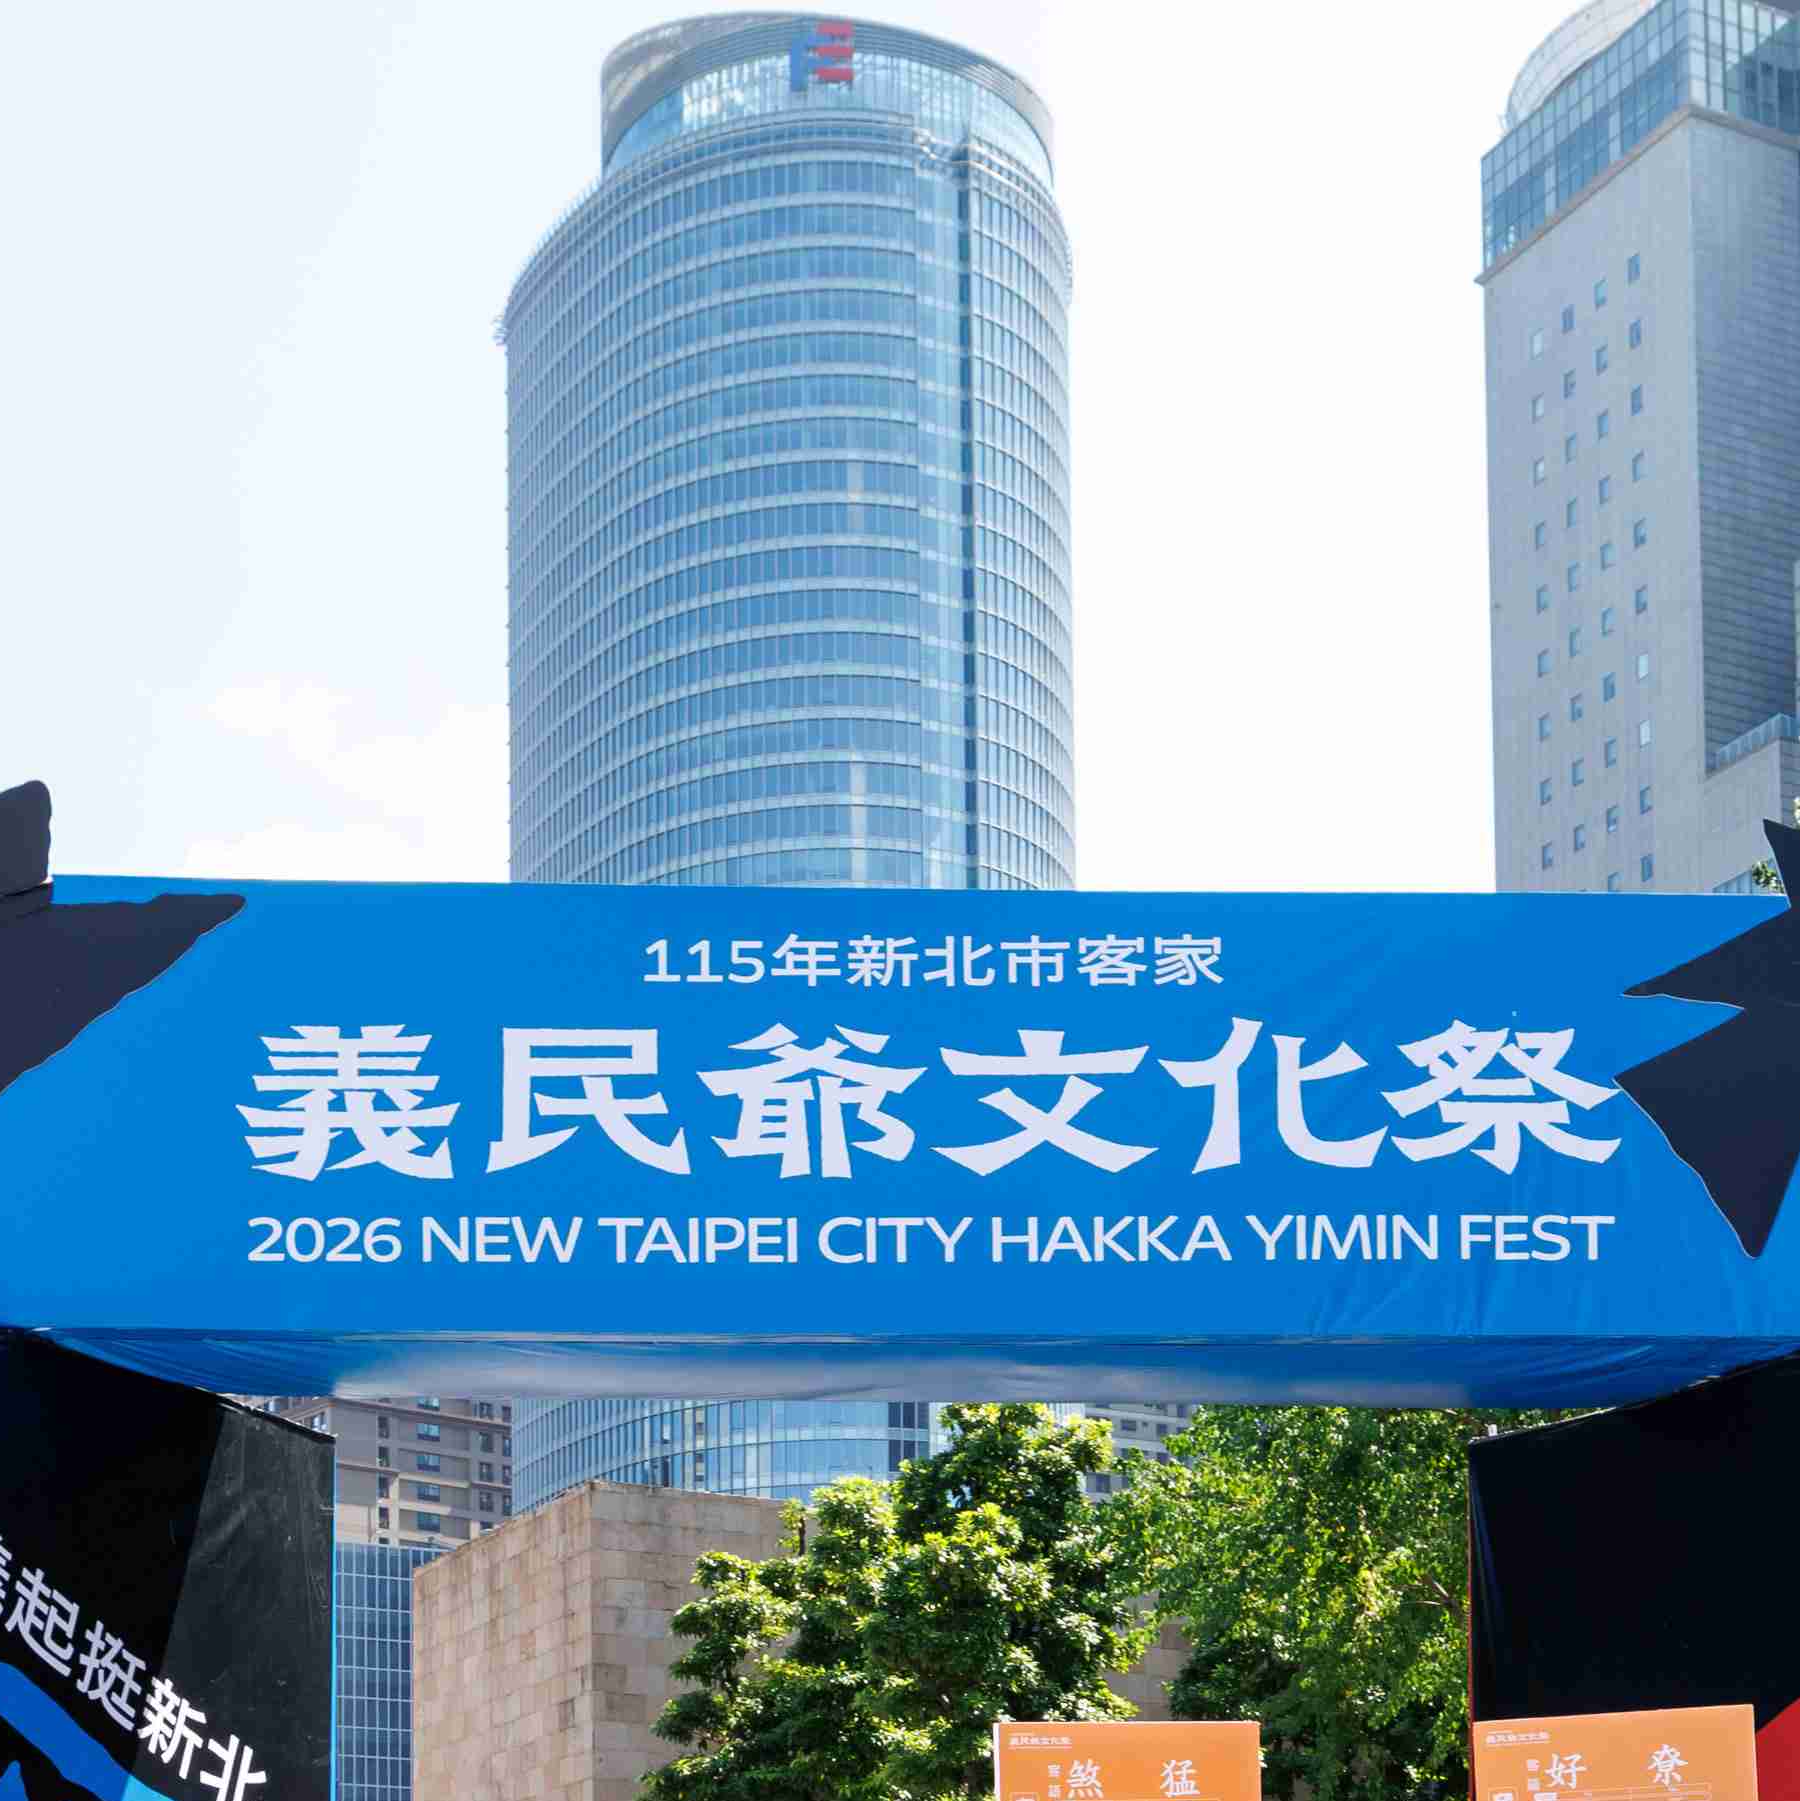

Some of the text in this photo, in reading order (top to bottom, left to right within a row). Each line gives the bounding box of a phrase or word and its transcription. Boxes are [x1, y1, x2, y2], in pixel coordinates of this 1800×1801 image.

[644, 934, 1223, 987] 115年新北市客家
[235, 1017, 1621, 1181] 義民爺文化祭
[247, 1214, 1615, 1264] 2026 NEW TAIPEI CITY HAKKA YIMIN FEST
